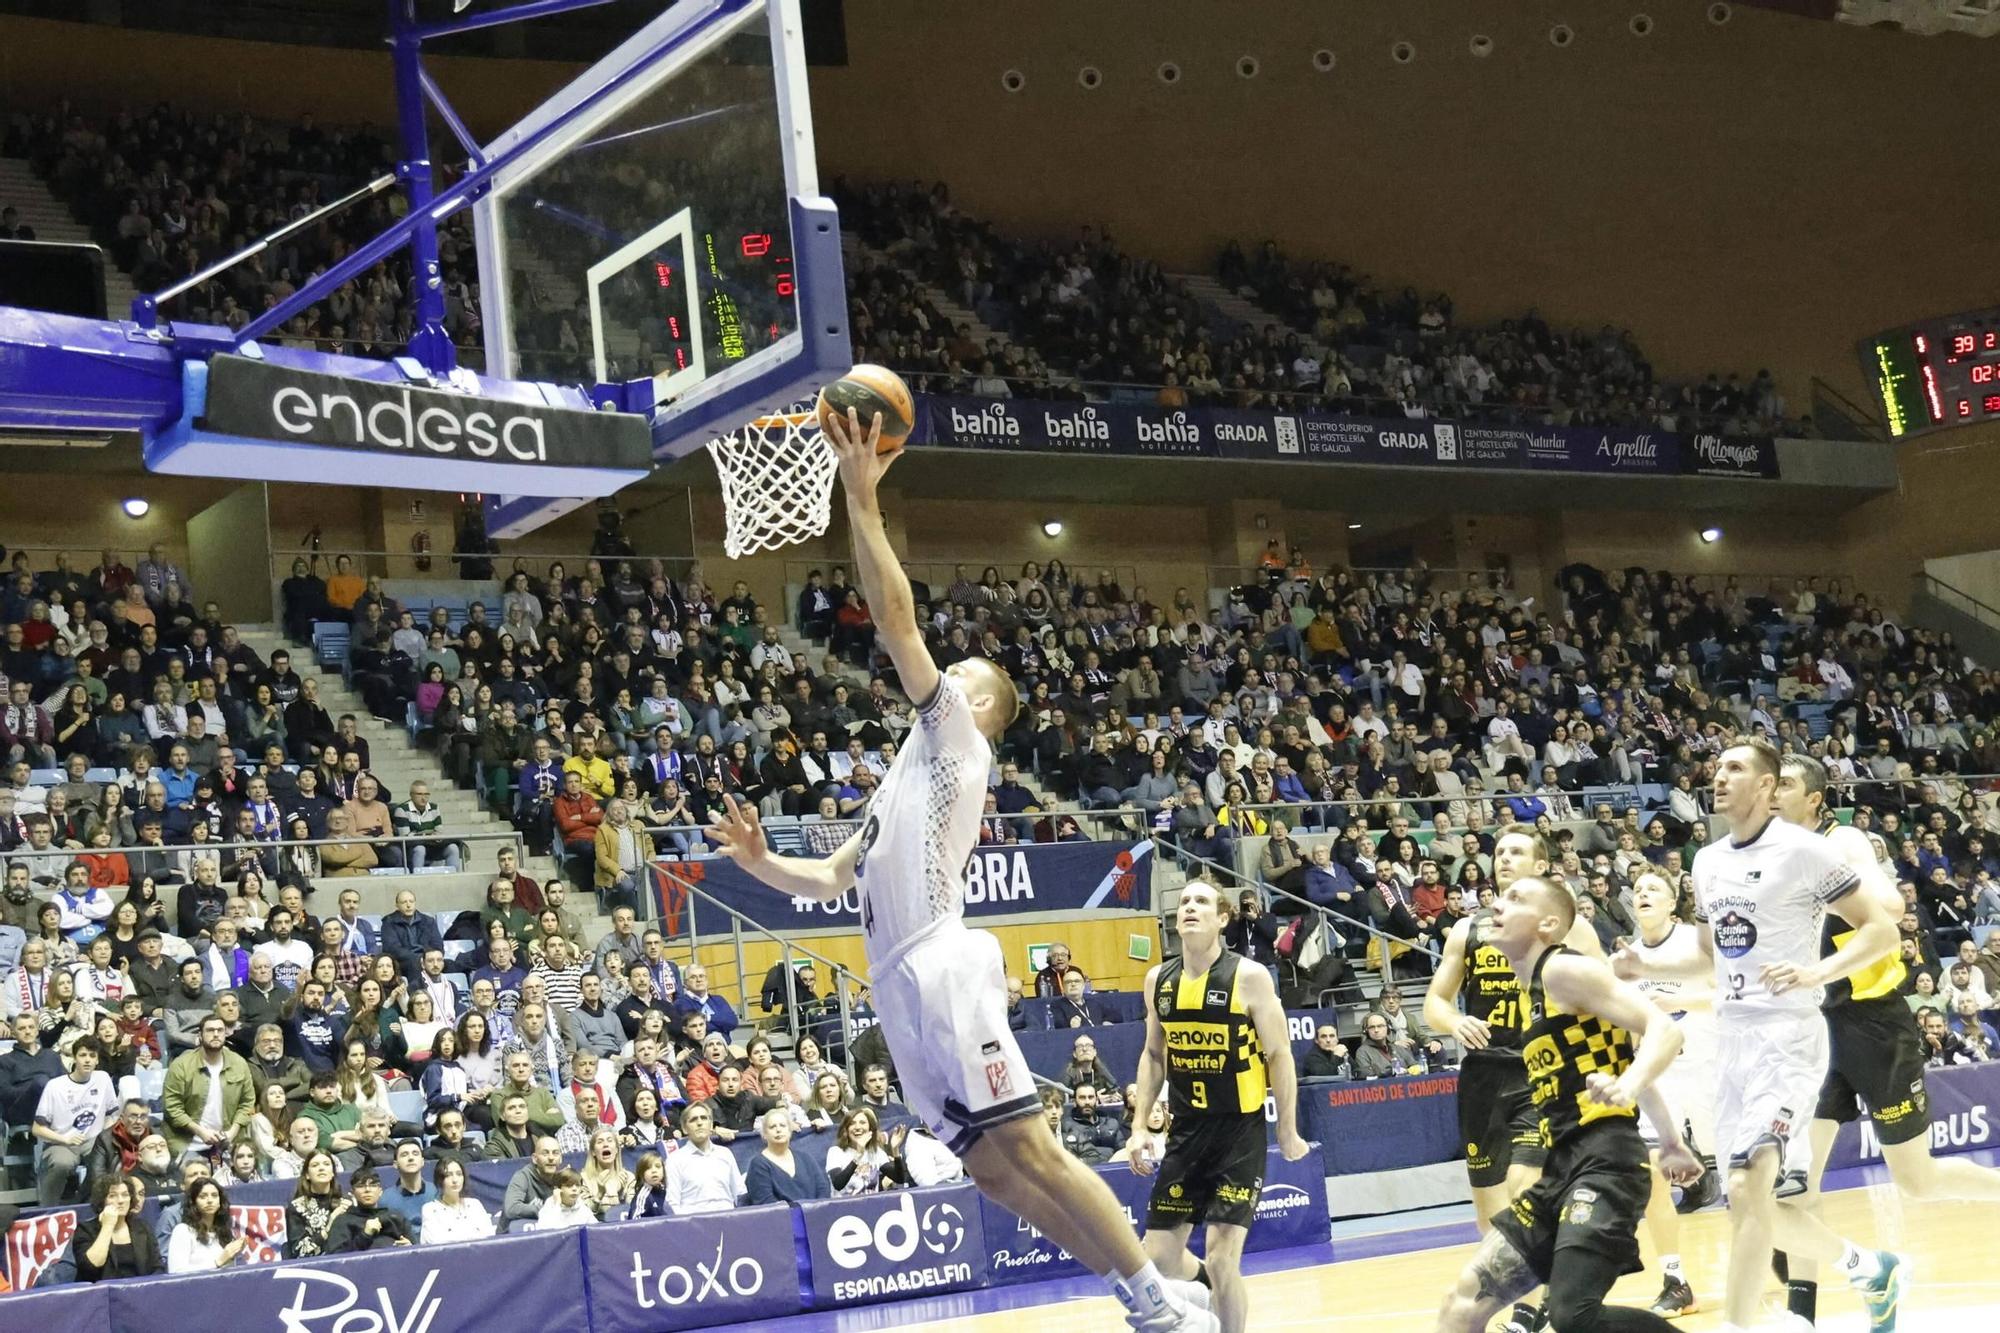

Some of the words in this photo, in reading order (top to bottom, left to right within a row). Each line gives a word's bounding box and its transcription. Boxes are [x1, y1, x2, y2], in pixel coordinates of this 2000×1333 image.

[1954, 335, 1974, 354] 39
[272, 386, 547, 462] endesa
[1214, 423, 1269, 443] GRADA
[1306, 422, 1338, 433] CENTRO
[1338, 423, 1374, 435] SUPERIOR
[1308, 432, 1319, 442] DE
[1378, 431, 1429, 449] GRADA
[1464, 429, 1493, 439] CENTRO
[1310, 443, 1321, 452] DE
[1321, 443, 1352, 454] GALICIA
[1465, 440, 1475, 448] DE
[1693, 434, 1760, 468] Milongas
[1477, 450, 1507, 459] GALICIA
[1487, 999, 1517, 1029] 21
[1191, 1081, 1208, 1109] 9
[1328, 1084, 1385, 1107] SANTIAGO
[1389, 1083, 1406, 1100] DE
[993, 1247, 1053, 1270] Puertas
[630, 1231, 764, 1309] toxo
